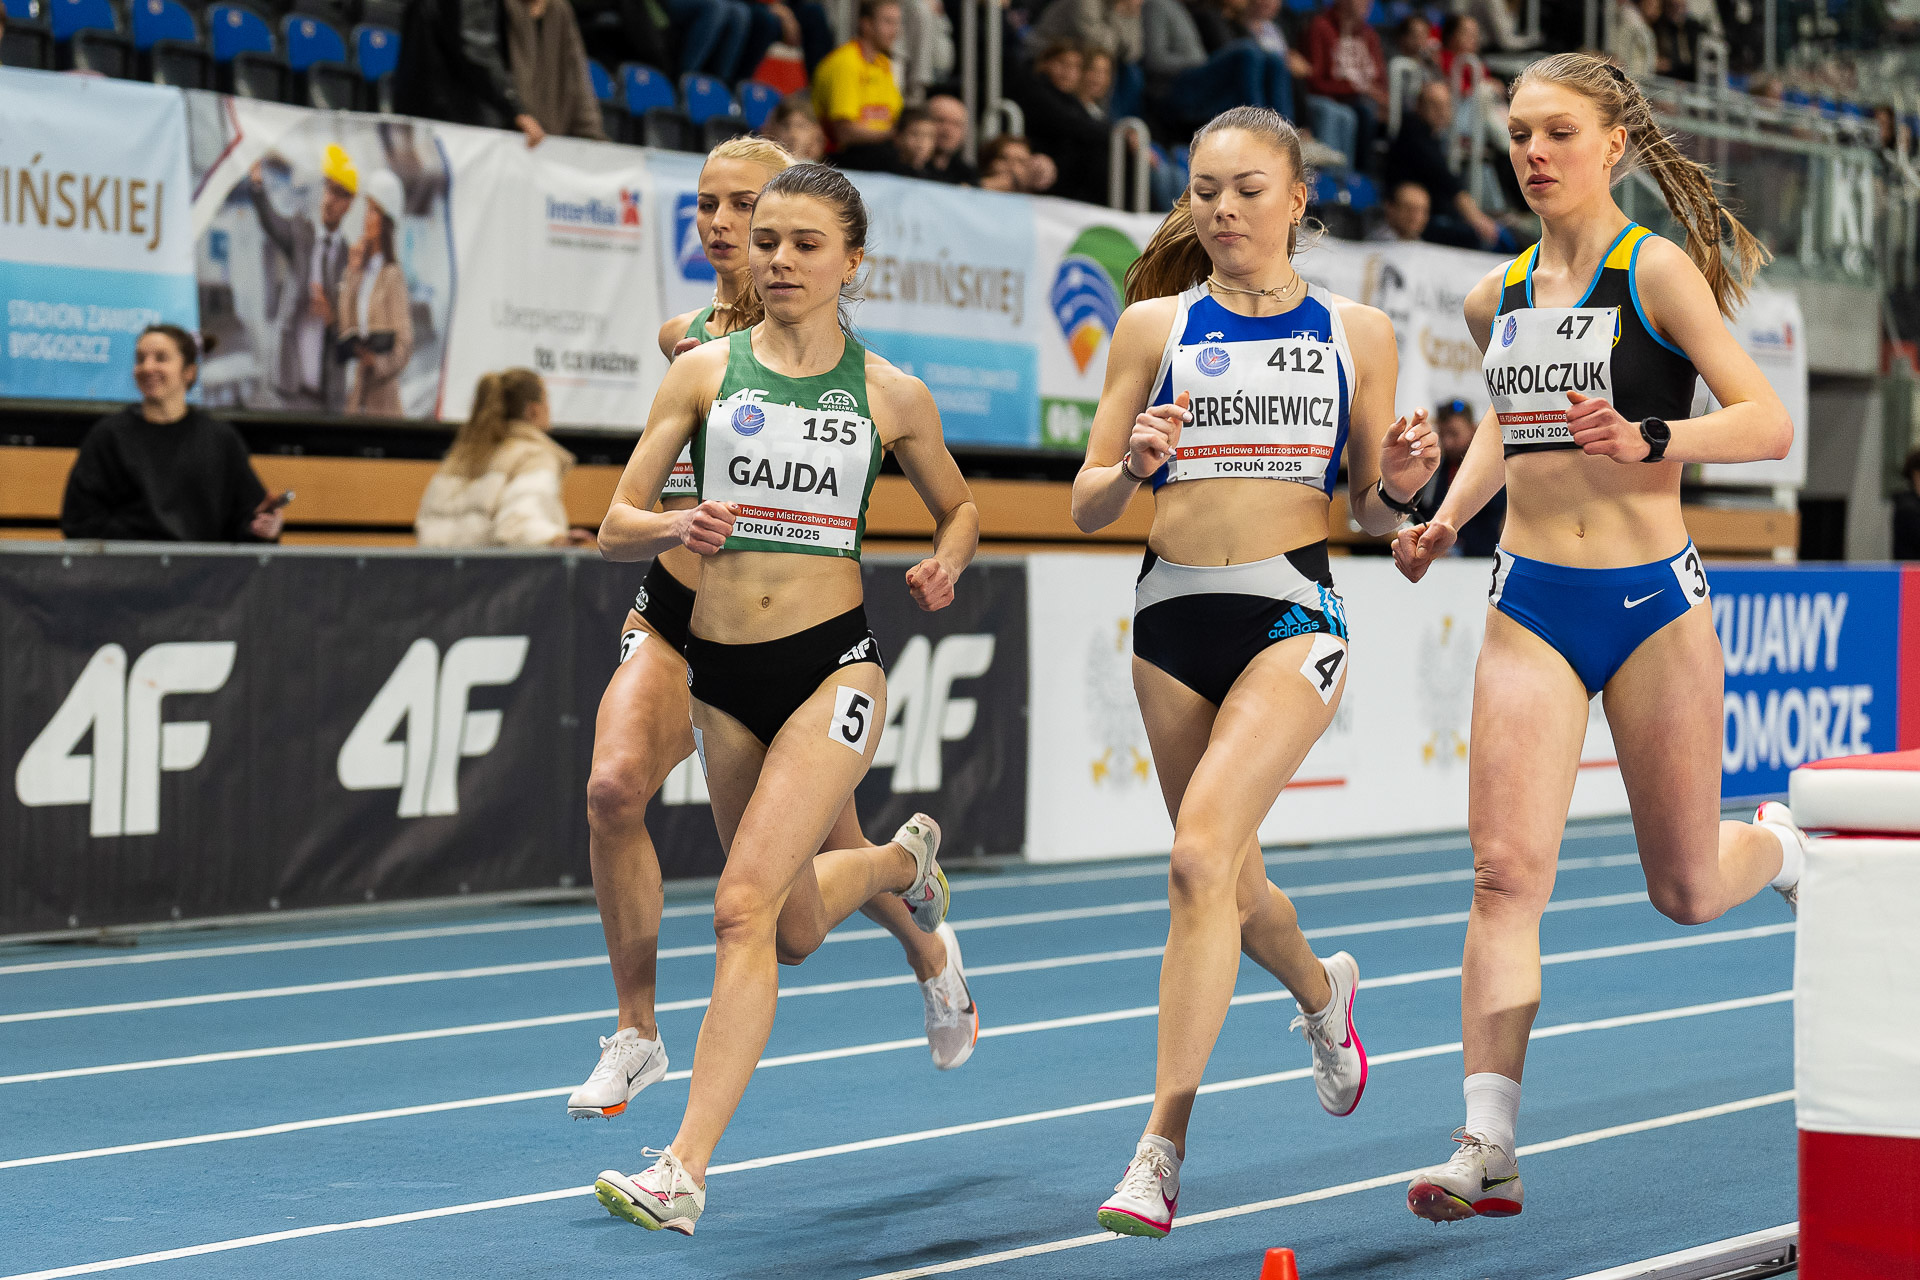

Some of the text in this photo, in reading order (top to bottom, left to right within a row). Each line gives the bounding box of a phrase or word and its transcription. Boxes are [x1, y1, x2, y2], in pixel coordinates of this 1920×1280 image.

[0, 153, 163, 250] IŃSKIEJ
[864, 248, 1025, 326] ZEWIŃSKIEJ
[1556, 316, 1594, 340] 47
[1267, 346, 1325, 374] 412
[1486, 361, 1607, 397] KAROLCZUK
[822, 404, 854, 412] WARSZAWA
[827, 394, 850, 405] AZS
[1535, 412, 1567, 421] Mistrzos
[803, 417, 857, 446] 155
[1547, 426, 1574, 438] 202
[1183, 445, 1331, 457] 69. PZLA Halowe Mistrzostwa Polski
[728, 455, 839, 498] GAJDA
[1214, 459, 1302, 473] TORUŃ 2025
[664, 475, 692, 488] ORUŃ
[736, 519, 820, 541] TORUŃ 2025
[742, 507, 852, 528] Halowe Mistrzostwa Polski
[1685, 552, 1706, 598] 3
[1268, 620, 1320, 639] adidas
[838, 636, 871, 665] 4F
[1314, 648, 1345, 692] 4
[337, 635, 530, 818] 4F
[841, 693, 870, 744] 5
[871, 632, 996, 794] 4F
[16, 642, 237, 838] 4F
[1722, 683, 1874, 776] OMORZE
